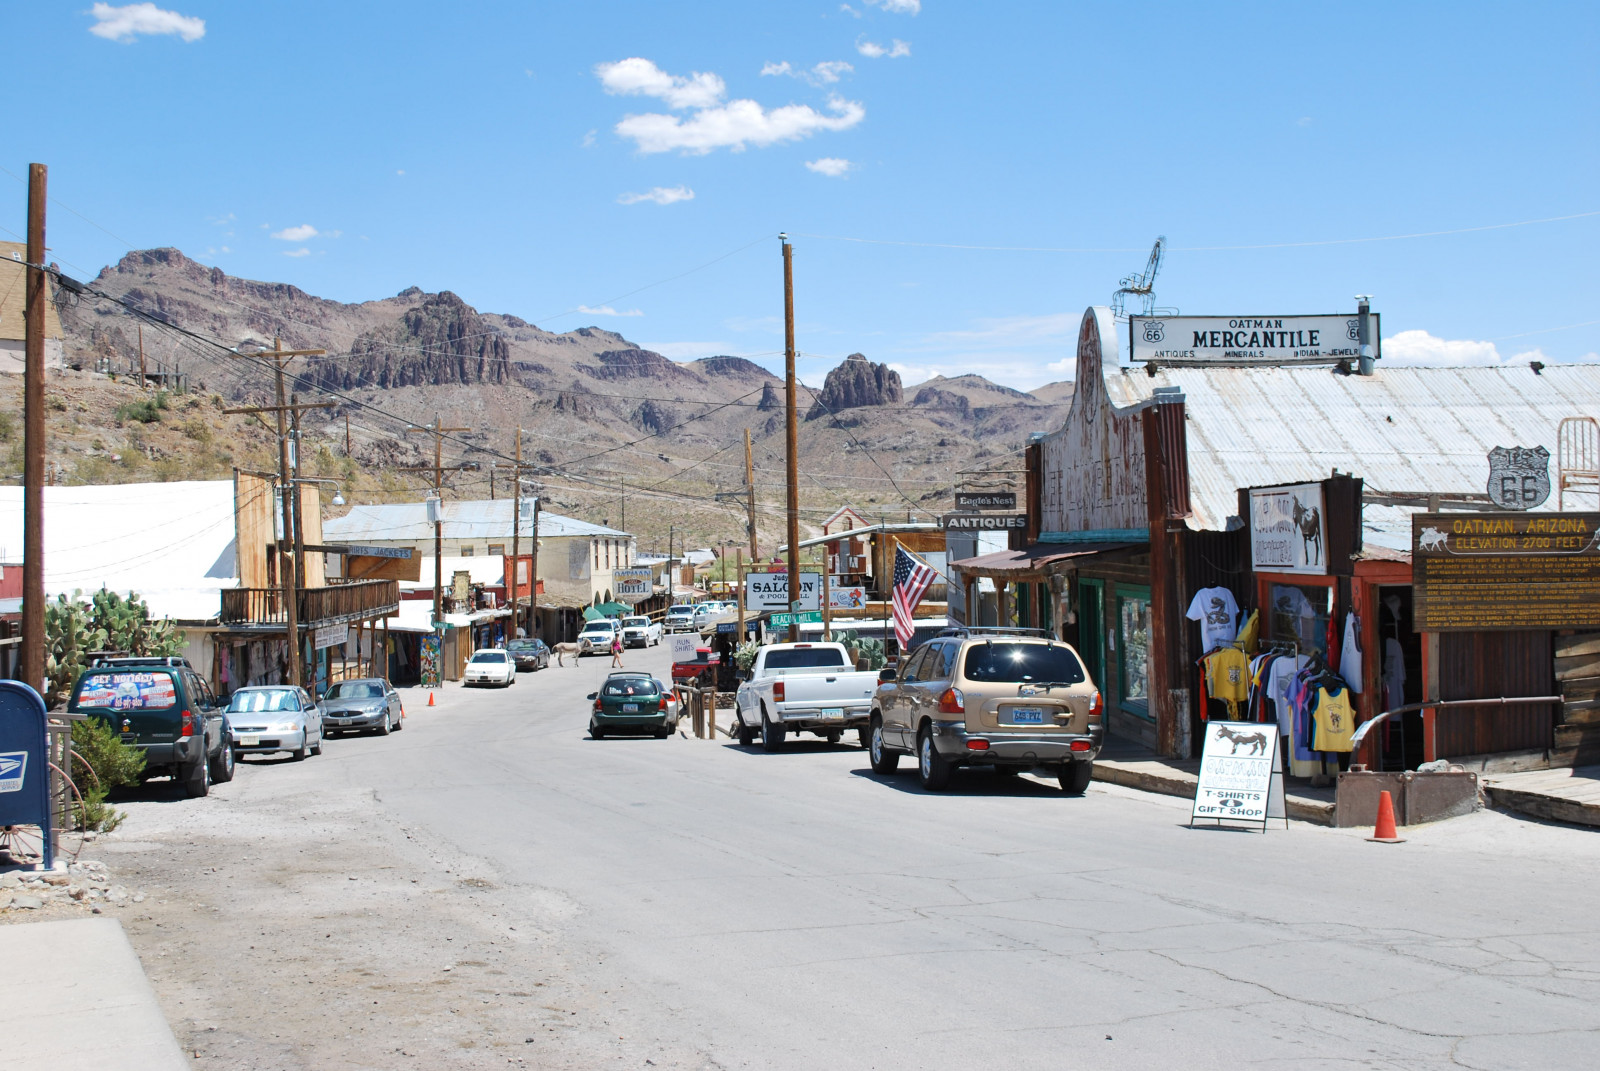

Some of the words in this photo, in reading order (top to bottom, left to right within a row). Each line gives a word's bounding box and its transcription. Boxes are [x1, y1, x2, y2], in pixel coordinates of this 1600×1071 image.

[1229, 319, 1282, 329] OATMAN
[1147, 330, 1161, 341] 66
[1192, 330, 1320, 348] MERCANTILE
[1154, 350, 1195, 358] ANTIQUES
[1224, 350, 1265, 358] MINERALS
[1293, 349, 1320, 358] INDIAN
[1328, 348, 1359, 356] JEWELR
[1501, 475, 1537, 502] 66
[960, 496, 991, 506] Eagle's
[992, 496, 1014, 505] Nest
[947, 518, 1026, 529] ANTIQUES
[1453, 519, 1517, 534] OATMAN,
[1526, 518, 1588, 533] ARIZONA
[1456, 537, 1517, 549] ELEVATION
[1522, 536, 1550, 548] 2700
[1556, 536, 1584, 548] FEET
[350, 546, 369, 555] IRTS
[375, 547, 410, 558] JACKETS
[773, 574, 789, 582] Judy
[617, 582, 649, 594] HOTEL
[752, 582, 814, 593] SALON
[772, 613, 797, 626] BEACON
[798, 613, 812, 624] HILL
[674, 644, 695, 653] SHIRTS
[93, 674, 111, 684] GET
[114, 673, 153, 684] NOTICED
[1206, 758, 1269, 778] OATMAN
[1205, 790, 1261, 801] T-SHIRTS
[1226, 799, 1235, 807] &
[1198, 805, 1226, 815] GIFT
[1229, 807, 1263, 817] SHOP
